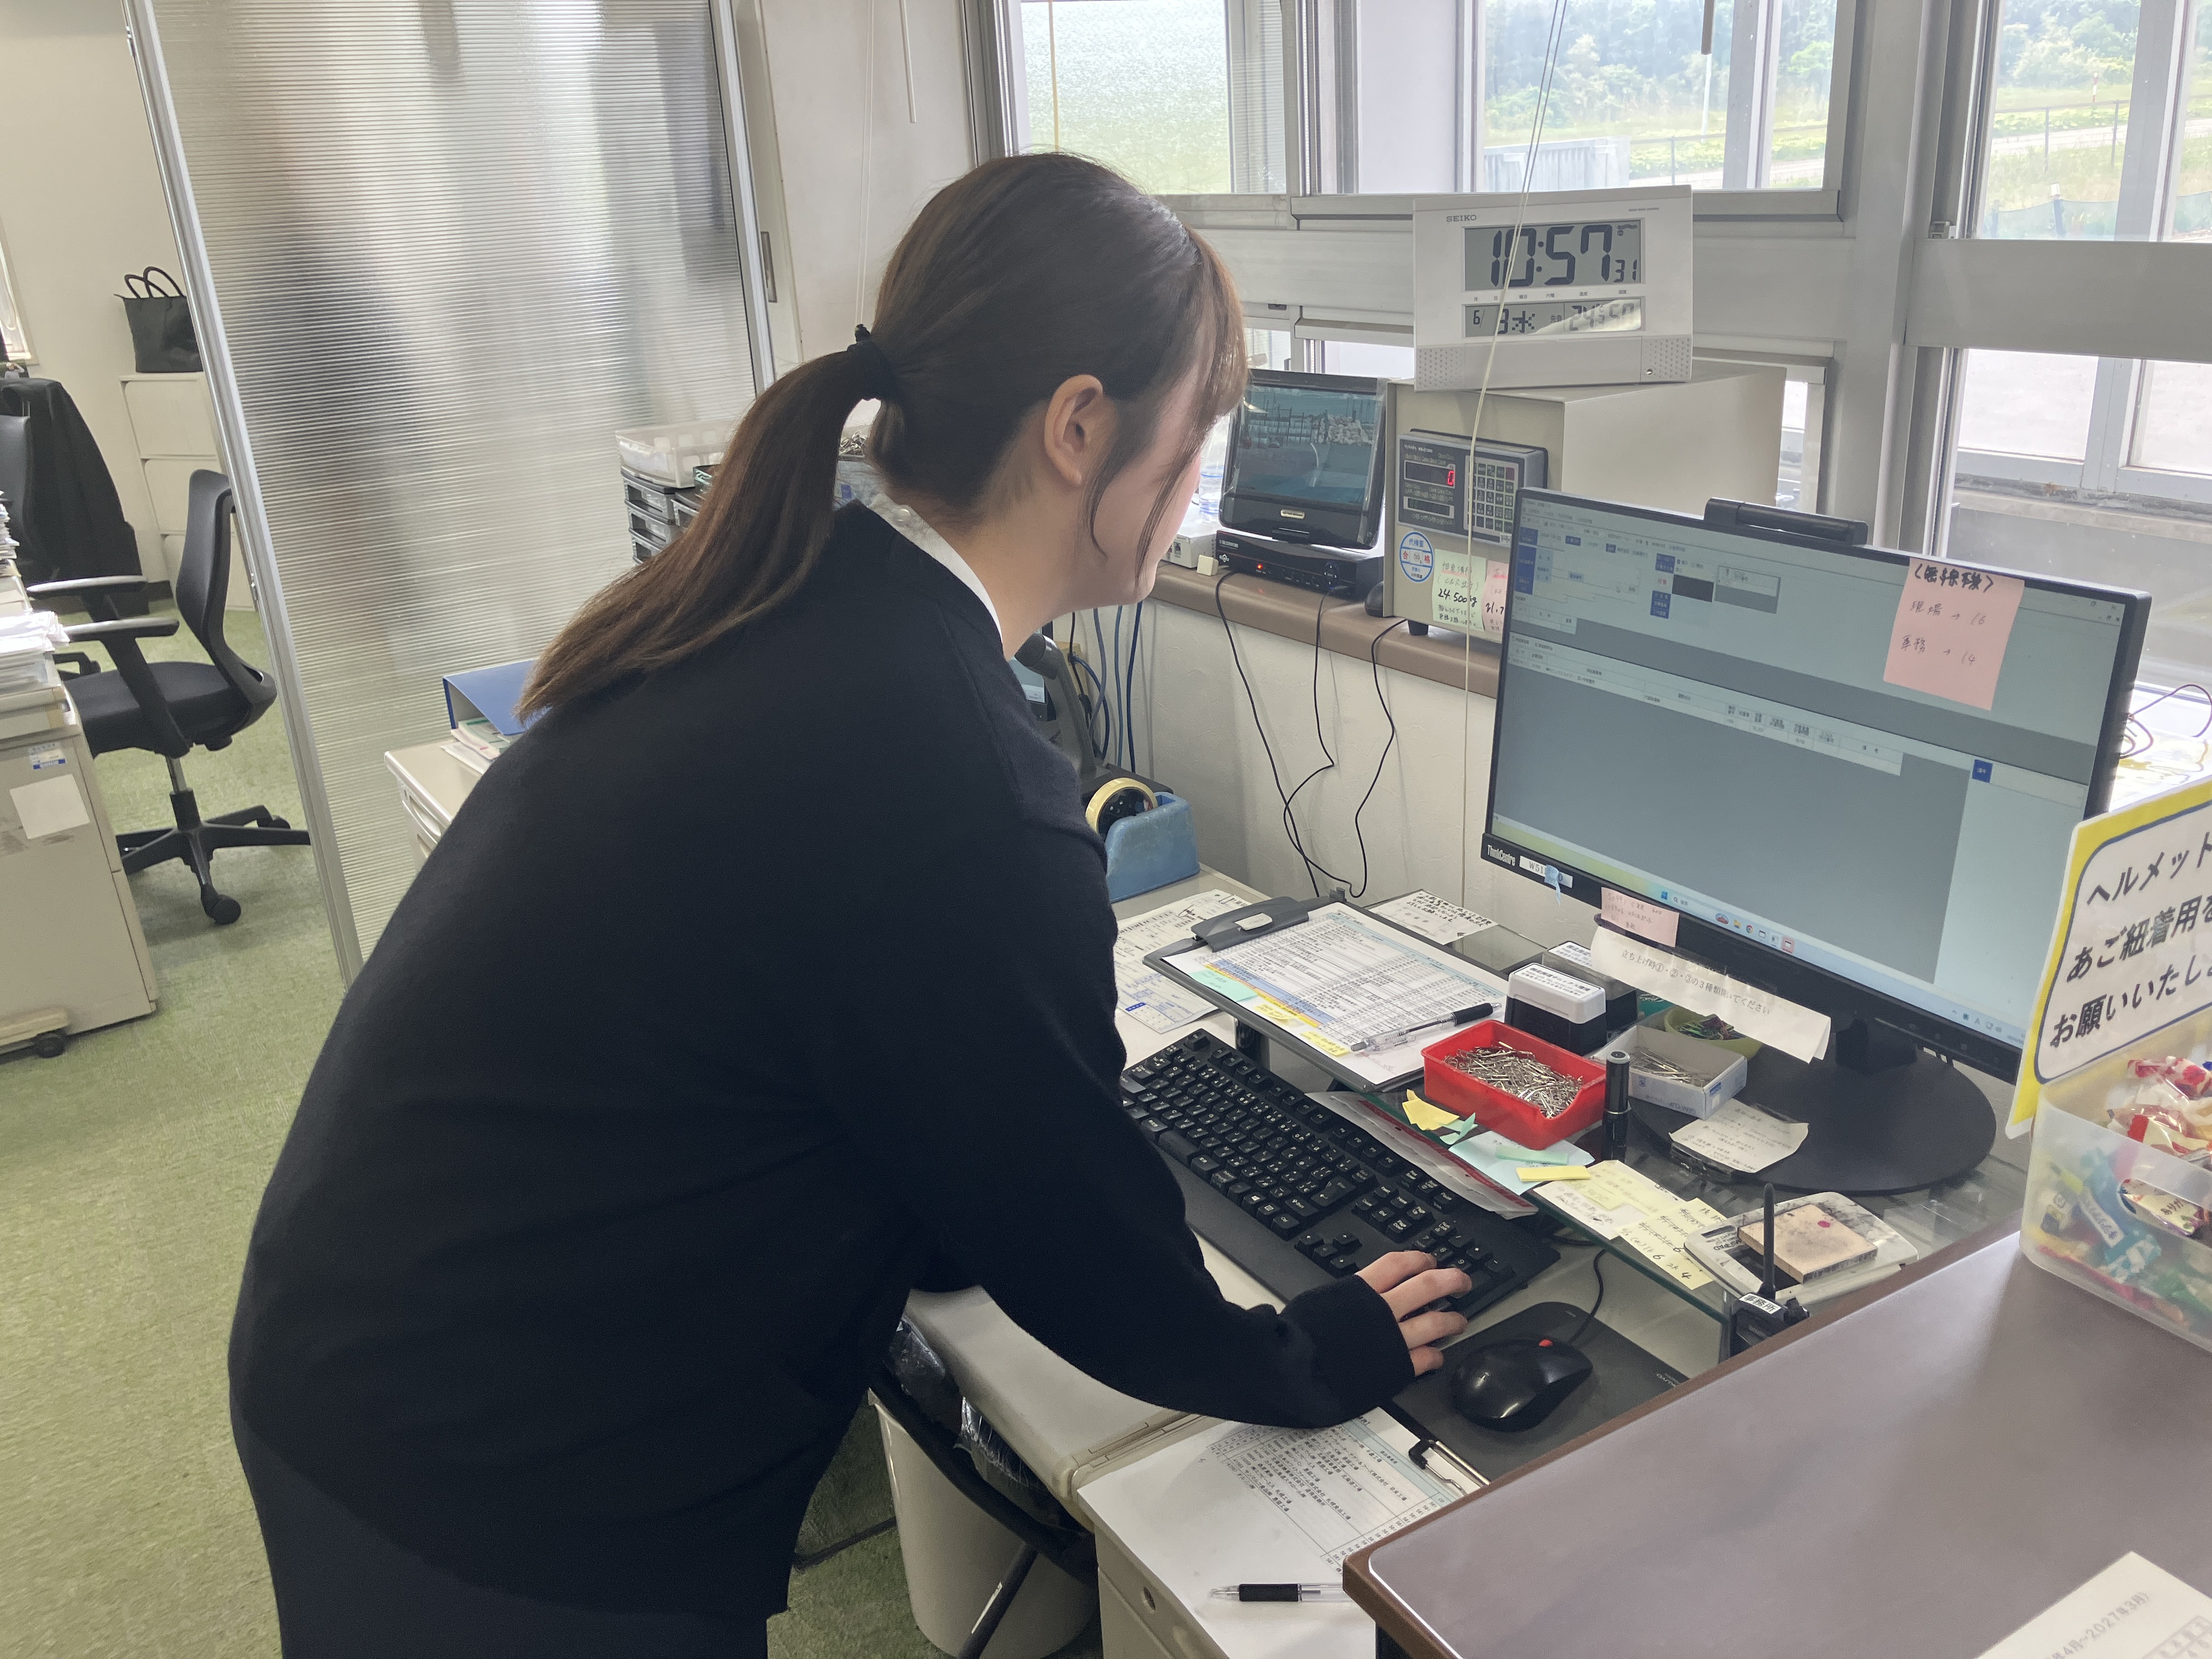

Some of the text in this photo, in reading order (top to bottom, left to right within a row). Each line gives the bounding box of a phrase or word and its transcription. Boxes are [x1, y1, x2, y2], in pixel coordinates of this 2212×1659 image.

[1446, 213, 1477, 223] SEIKO
[1613, 259, 1638, 283] 31
[1511, 311, 1536, 334] 水
[1447, 470, 1455, 486] 0
[1403, 551, 1408, 559] 合
[1487, 844, 1516, 867] ThinkCentre
[1743, 1294, 1779, 1313] 事務所
